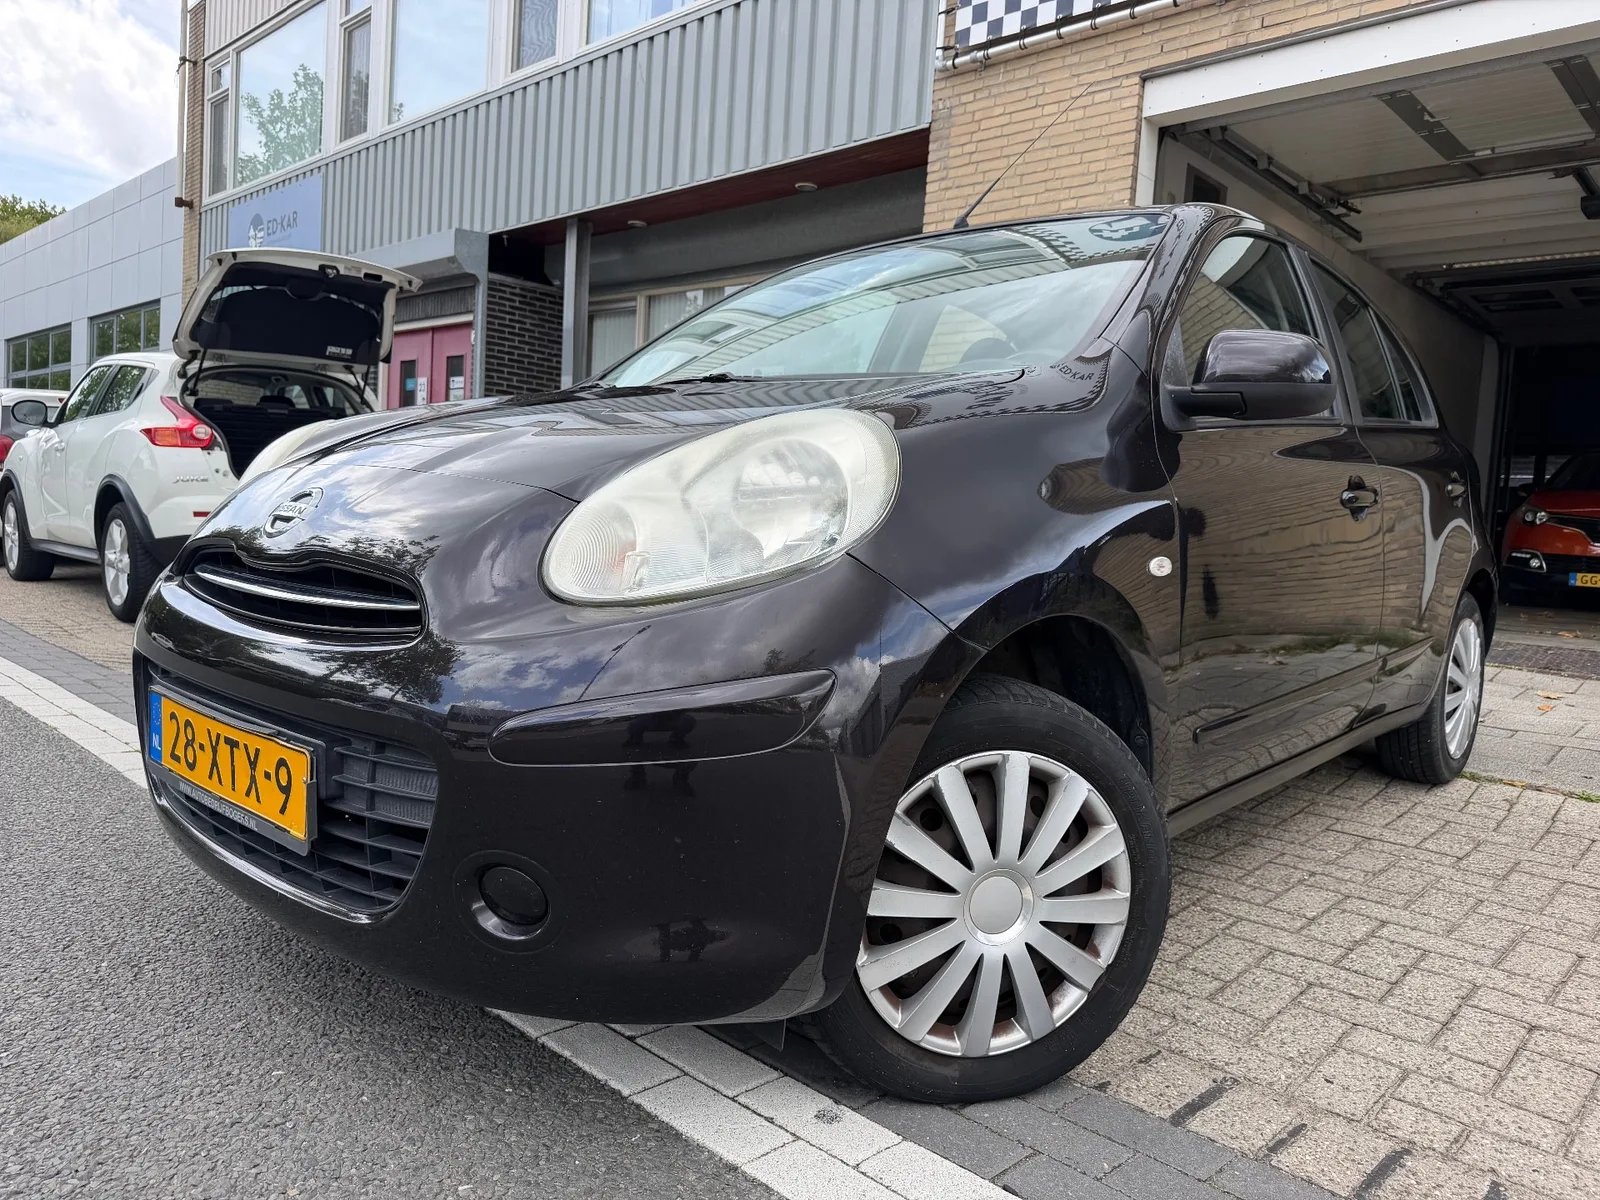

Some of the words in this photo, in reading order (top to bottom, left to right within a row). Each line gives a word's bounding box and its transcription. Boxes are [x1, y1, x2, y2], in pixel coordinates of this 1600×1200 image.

[172, 475, 209, 484] JUKE
[152, 733, 161, 751] NL
[169, 710, 293, 816] 28-XTX-9
